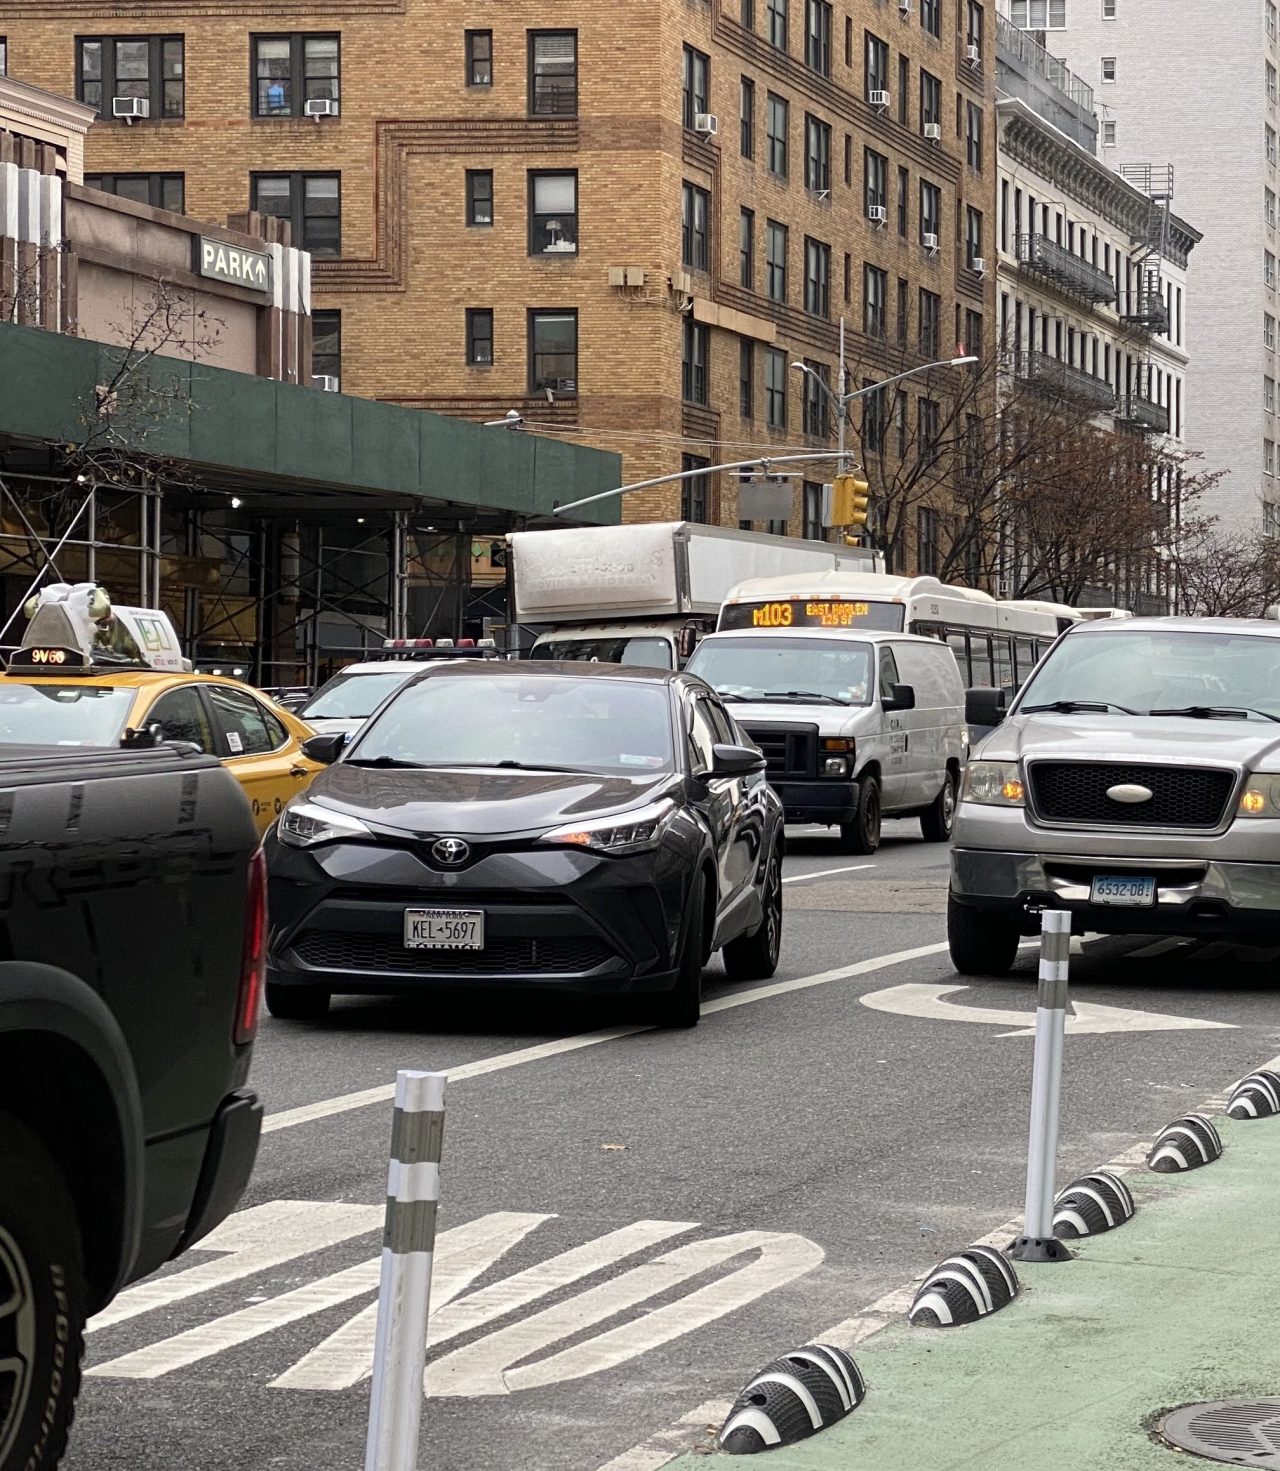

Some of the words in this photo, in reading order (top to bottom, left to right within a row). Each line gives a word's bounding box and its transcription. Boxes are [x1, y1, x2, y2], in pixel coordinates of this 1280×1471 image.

[203, 244, 254, 281] PARK
[753, 604, 792, 625] M103
[806, 604, 830, 616] EAST
[832, 603, 868, 615] HARLEM
[821, 616, 838, 625] 125
[412, 920, 436, 939] KEL
[445, 921, 476, 940] 5697
